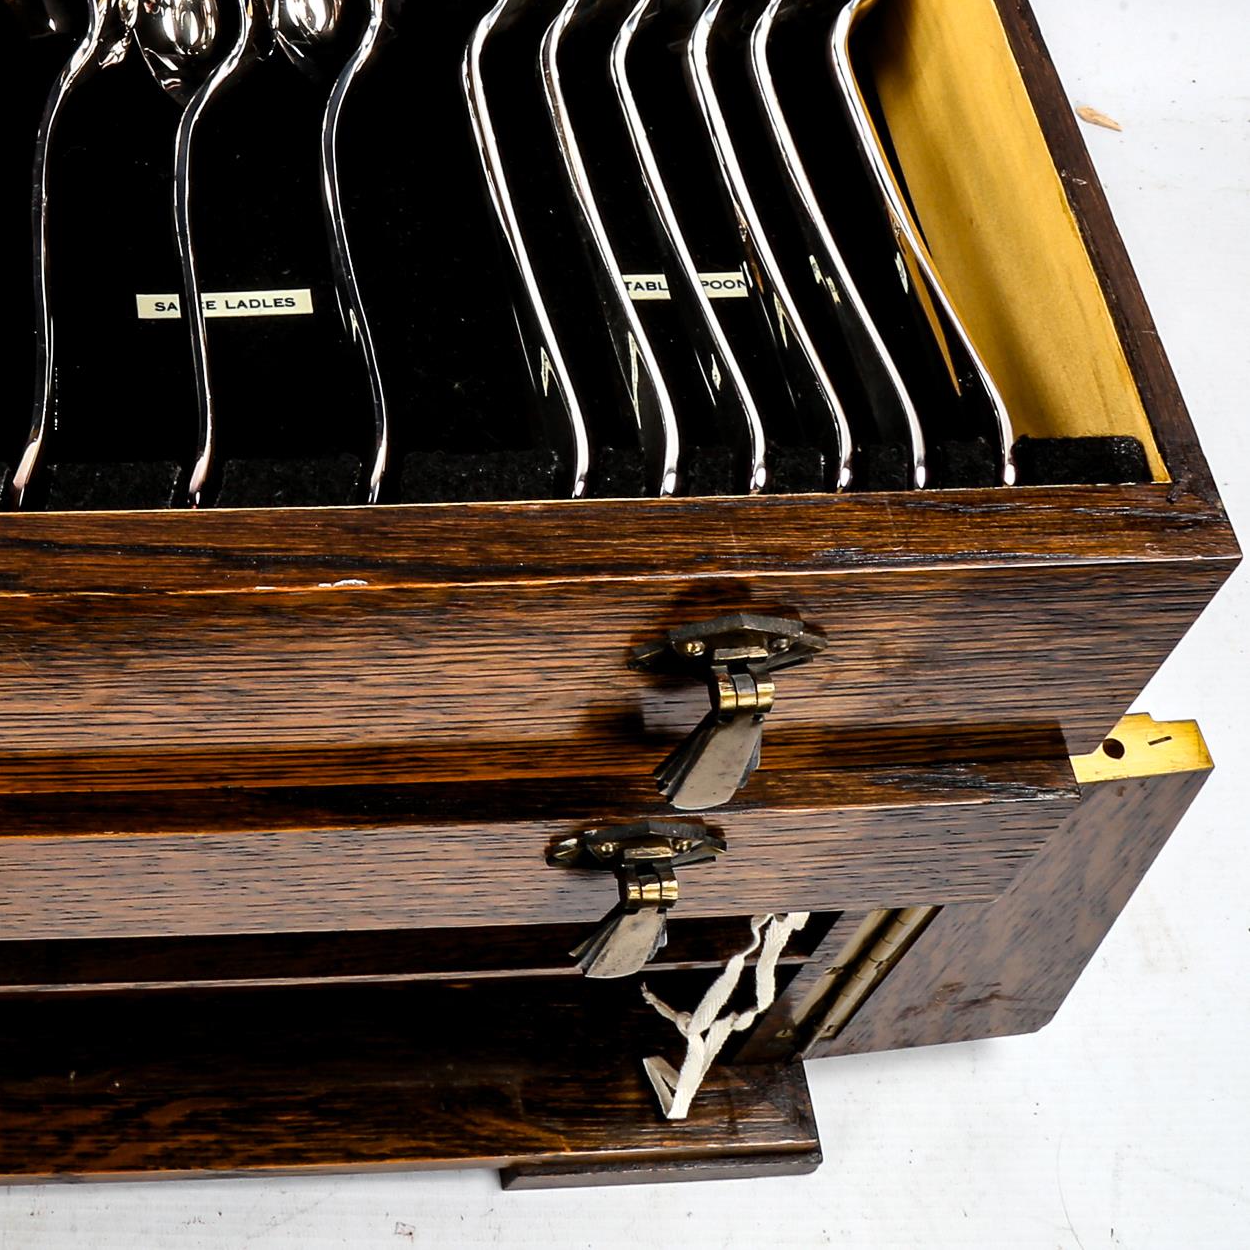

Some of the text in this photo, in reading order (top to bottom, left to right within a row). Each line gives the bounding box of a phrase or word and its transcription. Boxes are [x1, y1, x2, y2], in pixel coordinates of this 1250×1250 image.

[624, 281, 669, 291] TABL
[154, 297, 296, 312] SAE LADLES
